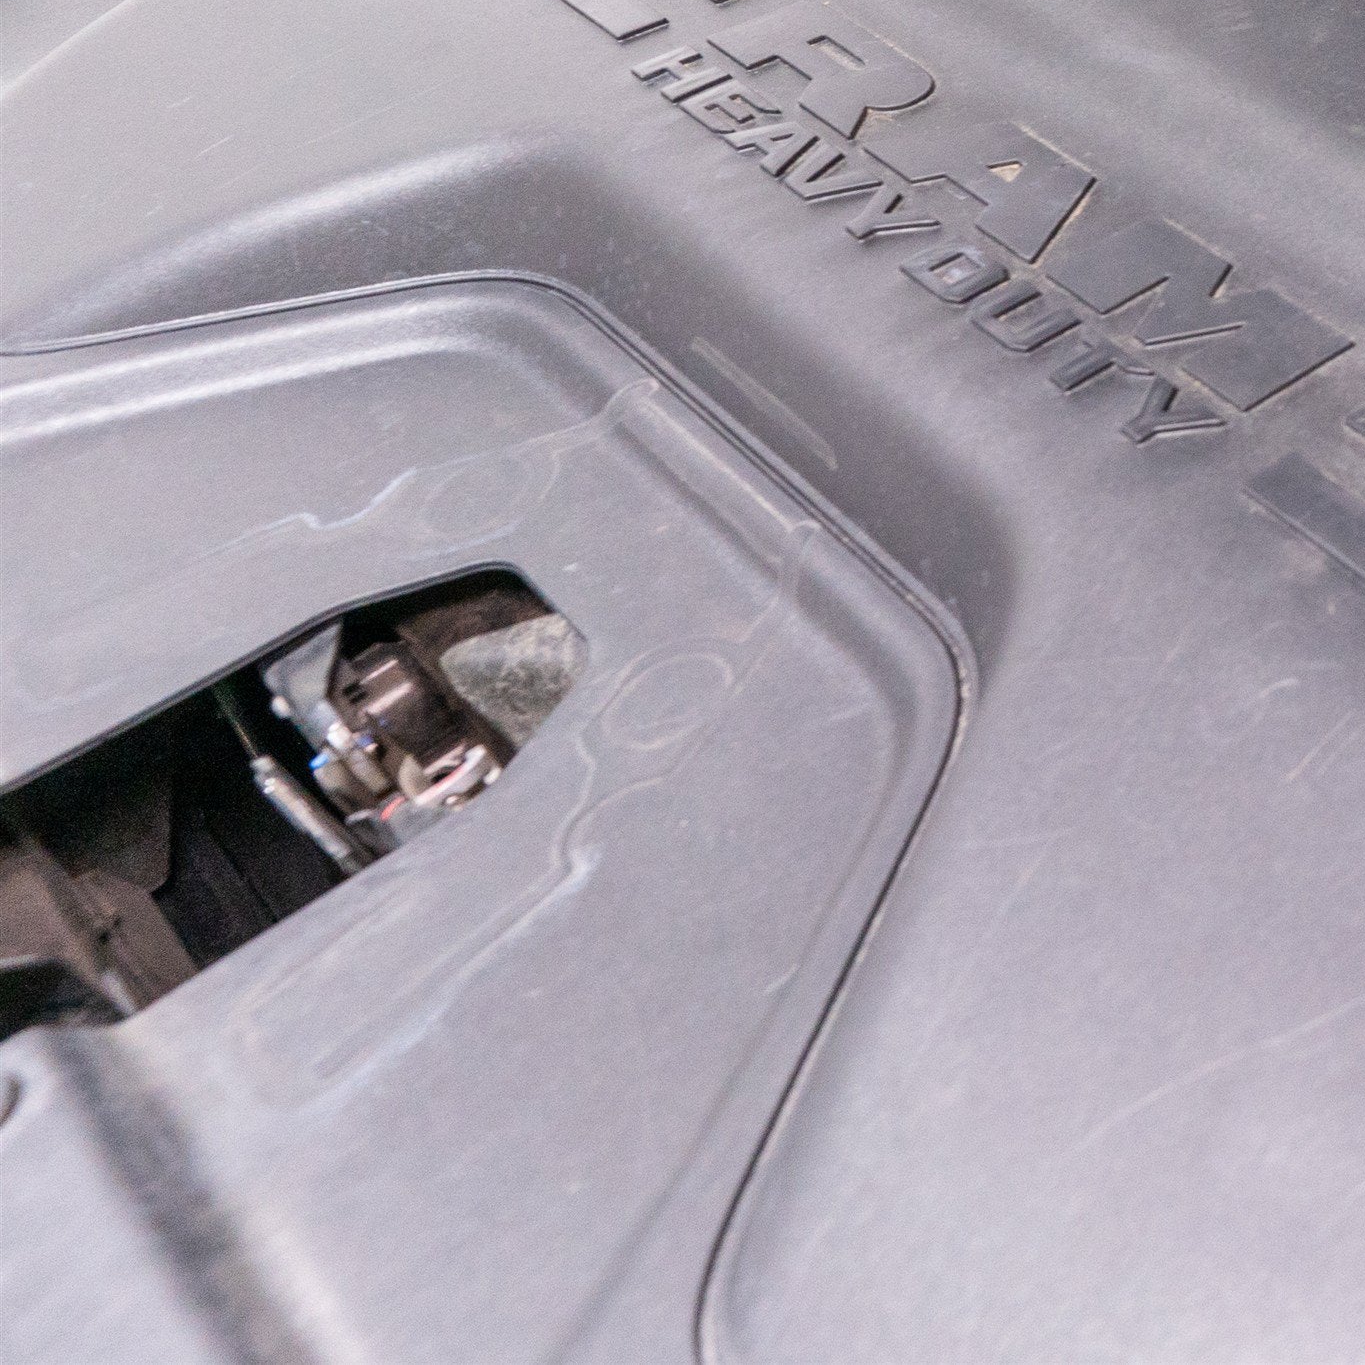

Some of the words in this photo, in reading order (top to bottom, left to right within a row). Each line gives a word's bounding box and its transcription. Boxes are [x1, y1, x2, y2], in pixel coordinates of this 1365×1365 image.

[630, 44, 942, 241] HEAVY
[900, 242, 1227, 445] DUTY
[706, 1, 1356, 413] RAM
